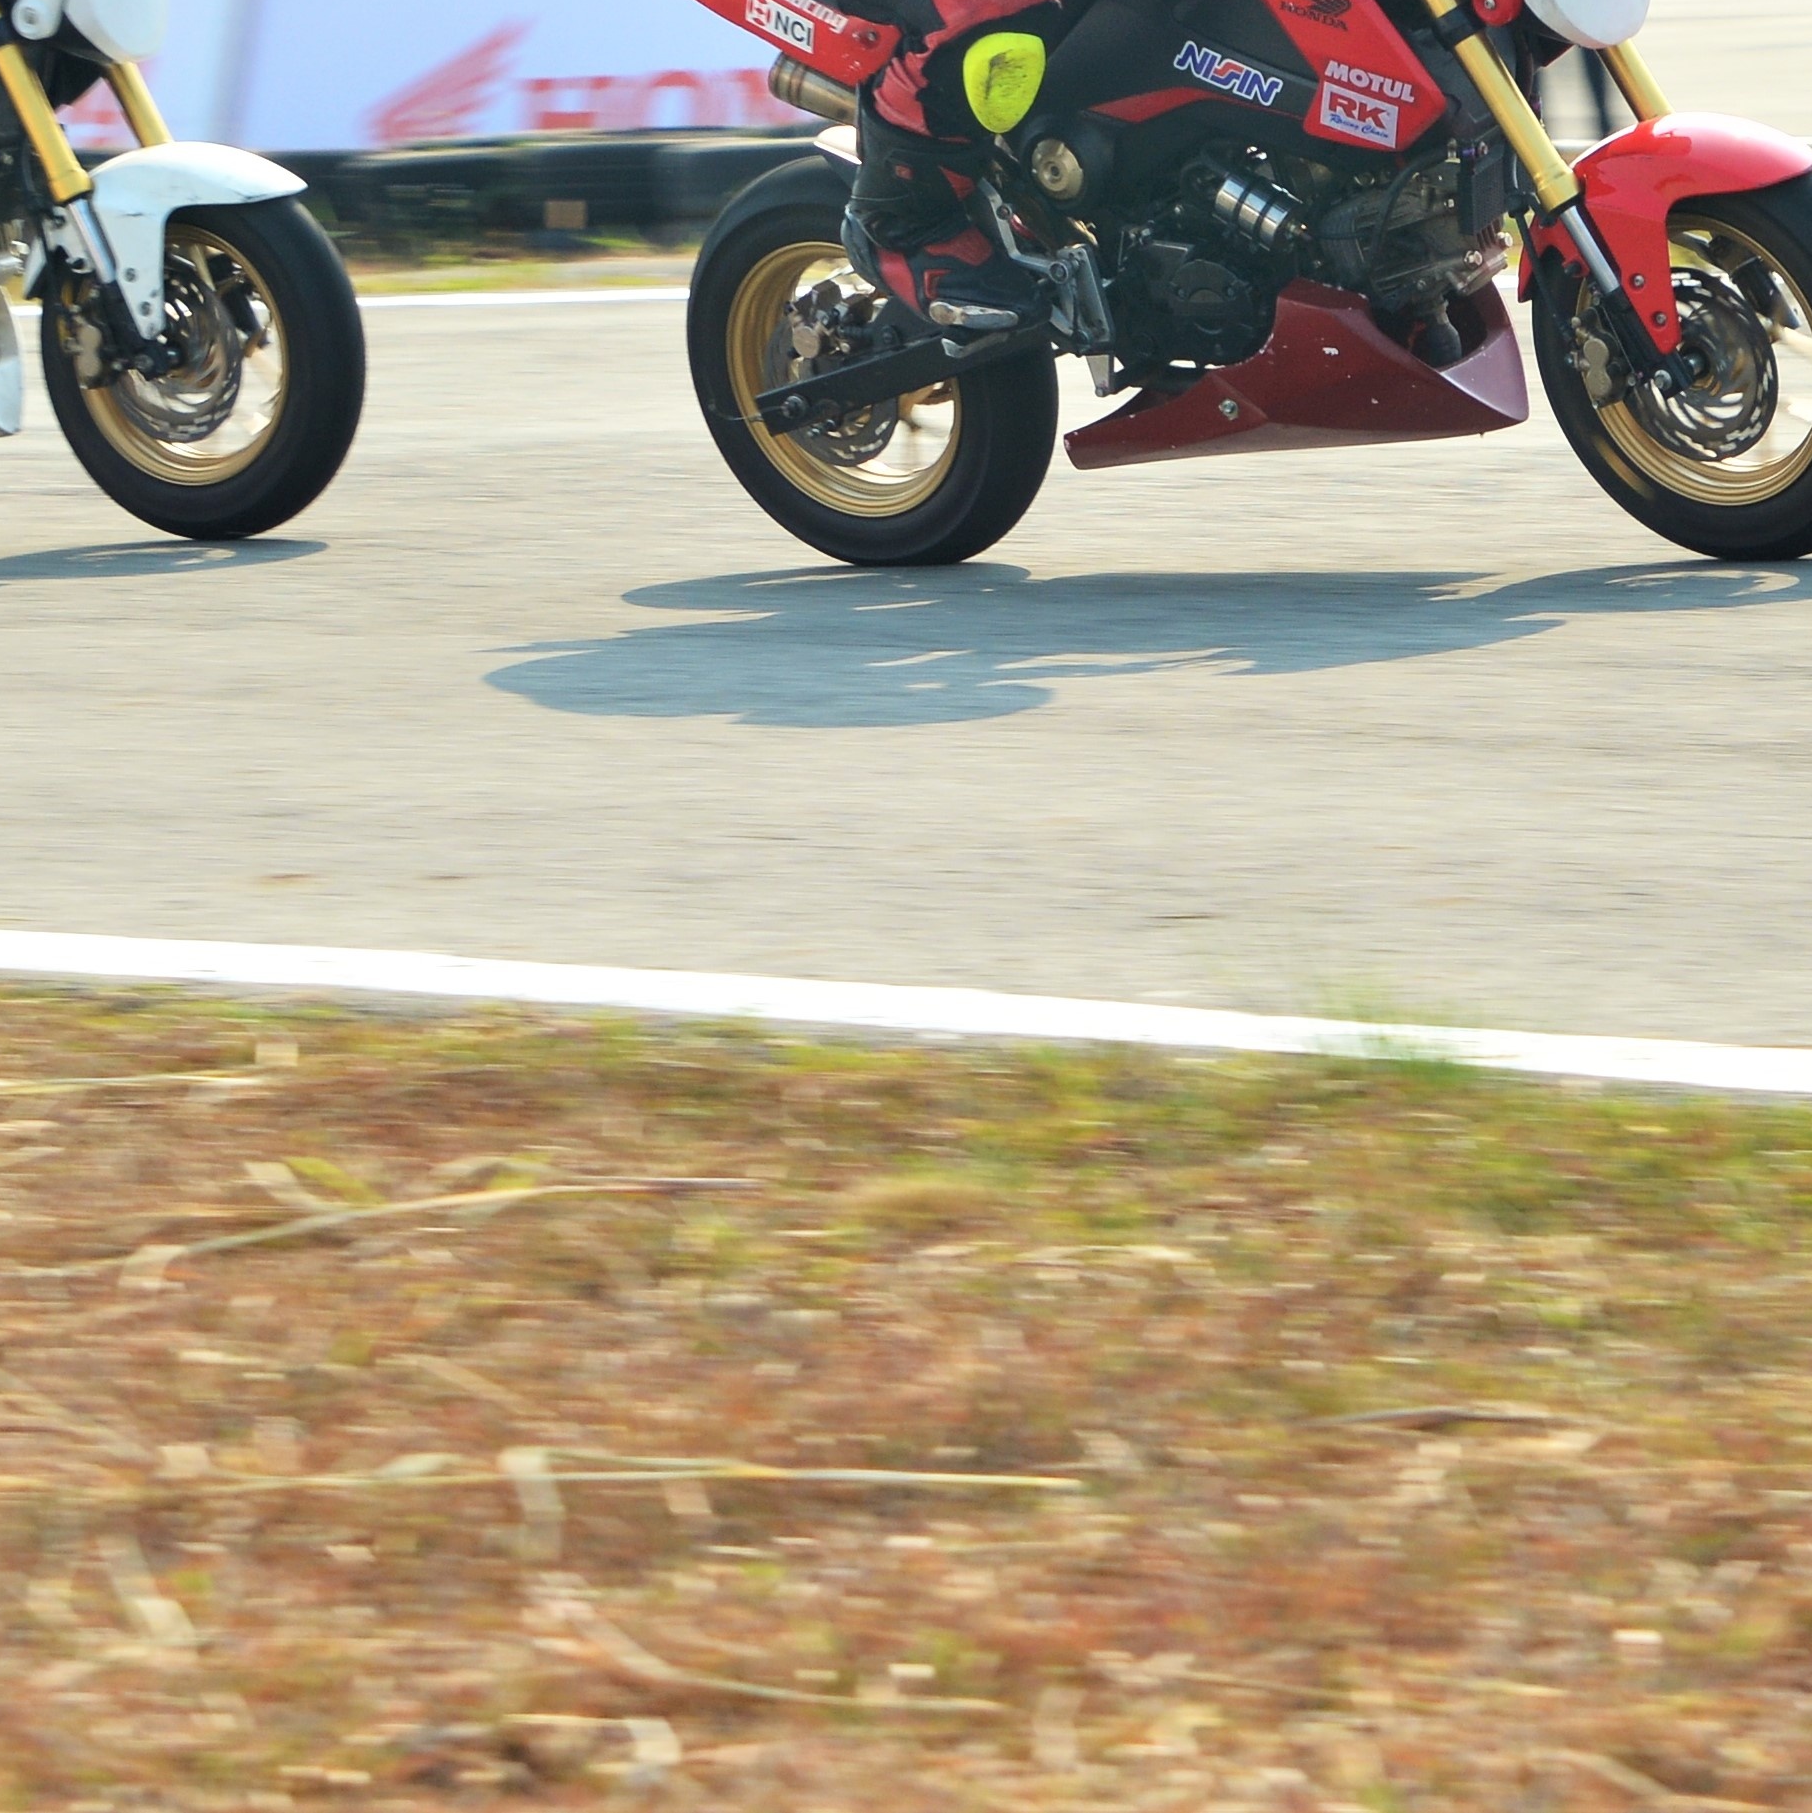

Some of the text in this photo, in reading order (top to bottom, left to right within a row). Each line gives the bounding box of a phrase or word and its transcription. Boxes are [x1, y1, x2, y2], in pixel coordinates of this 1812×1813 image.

[774, 10, 812, 49] NCI
[1279, 1, 1349, 31] HONDA
[1324, 60, 1415, 103] MOTUL
[1328, 91, 1387, 129] RK
